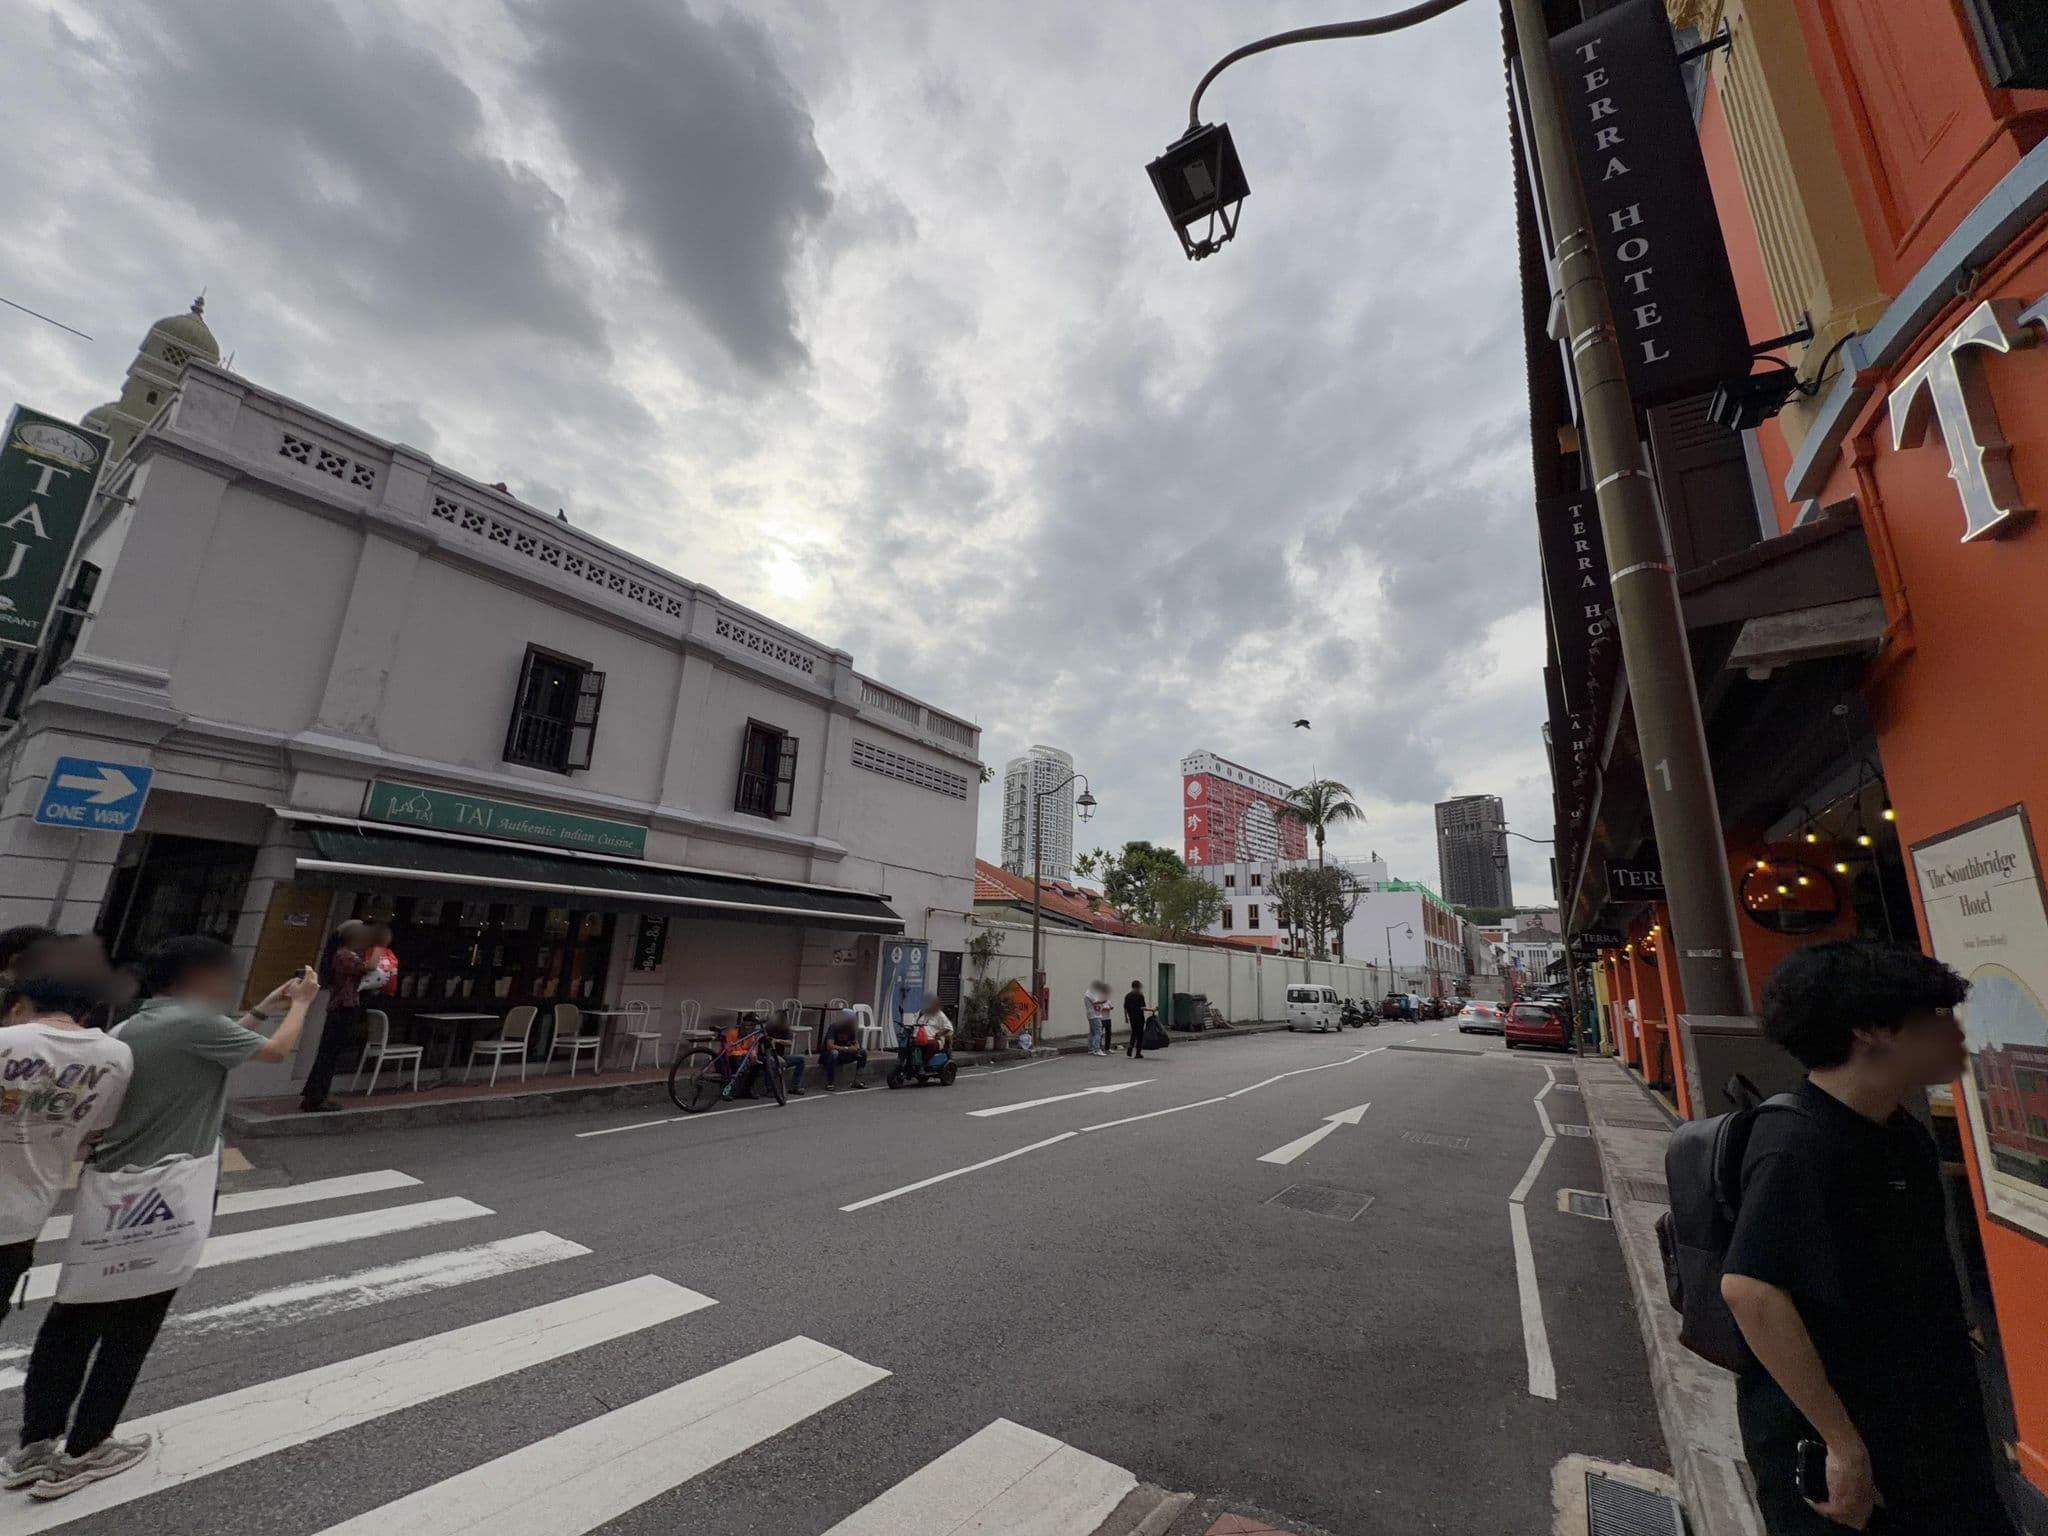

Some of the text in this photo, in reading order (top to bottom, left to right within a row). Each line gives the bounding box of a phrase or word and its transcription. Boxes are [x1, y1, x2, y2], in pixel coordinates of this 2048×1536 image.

[1576, 38, 1670, 365] TERRA HOTEL
[1888, 292, 2048, 543] T
[0, 459, 71, 581] TAJ
[1568, 504, 1599, 588] TERRA
[1655, 759, 1673, 791] 1
[45, 803, 131, 825] ONE WAY
[455, 803, 634, 850] TAJ Authentic Indian Cuisine
[1613, 868, 1664, 886] TER
[1927, 849, 2017, 890] The Southbridge
[1959, 890, 1993, 917] Hotel
